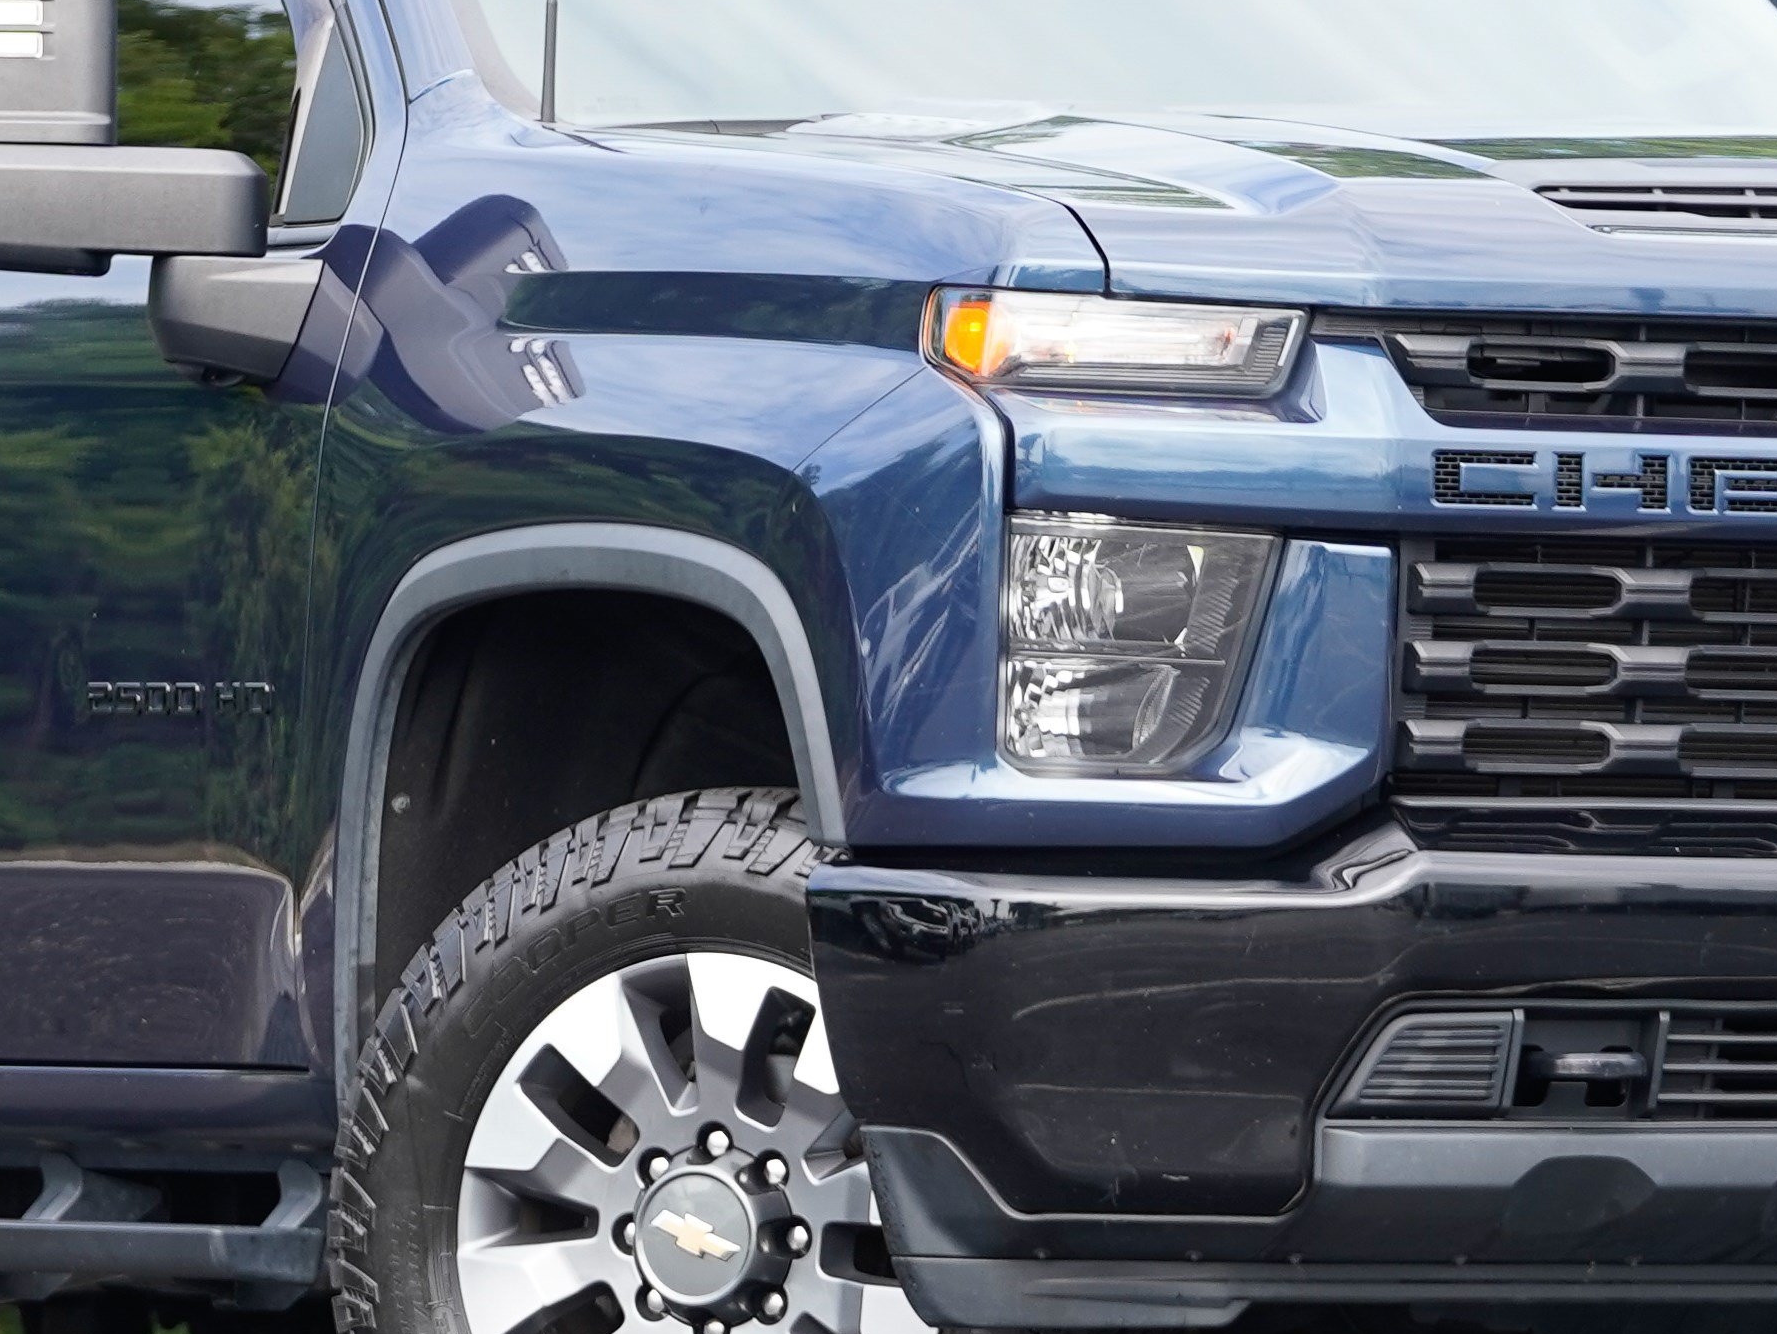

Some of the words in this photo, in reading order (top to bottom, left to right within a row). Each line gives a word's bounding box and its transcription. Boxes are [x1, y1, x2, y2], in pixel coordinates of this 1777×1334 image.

[86, 681, 205, 715] 2500
[215, 681, 276, 715] HD
[460, 885, 689, 1041] COOPER
